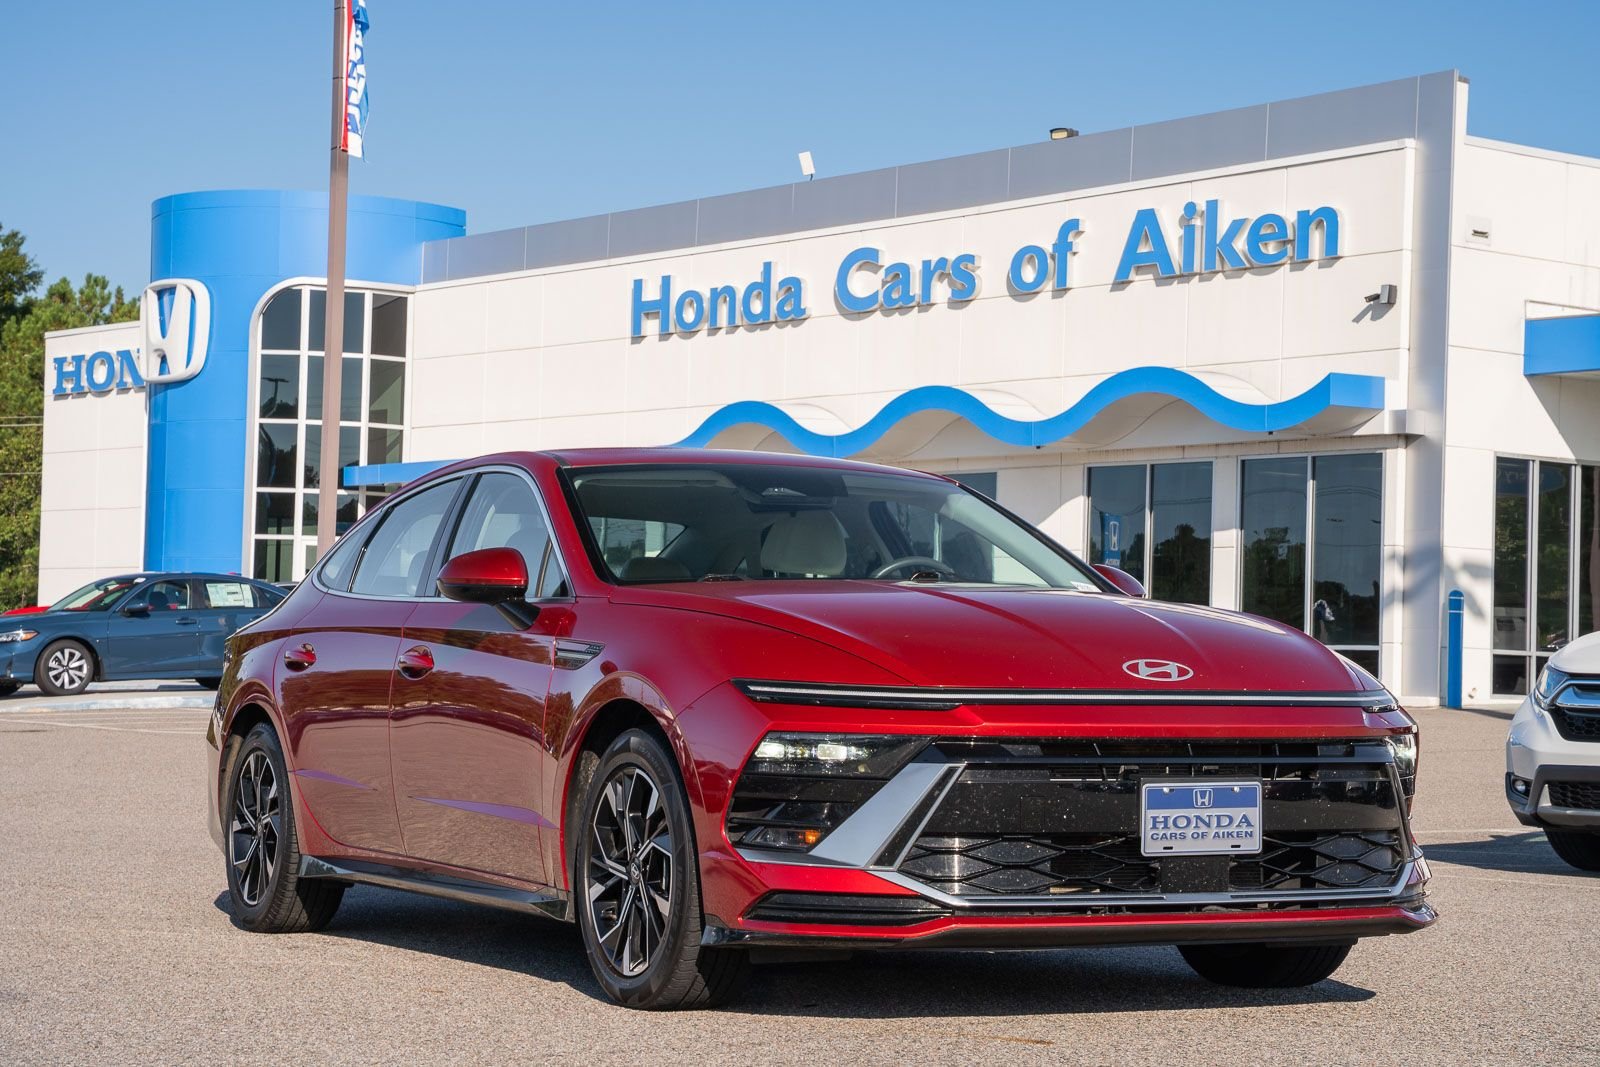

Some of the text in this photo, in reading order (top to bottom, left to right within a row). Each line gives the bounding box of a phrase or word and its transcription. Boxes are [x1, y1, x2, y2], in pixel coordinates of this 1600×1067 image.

[631, 199, 1339, 337] Honda Cars of Aiken
[1150, 813, 1254, 830] HONDA
[1150, 830, 1254, 841] CARS OF AIKEN
